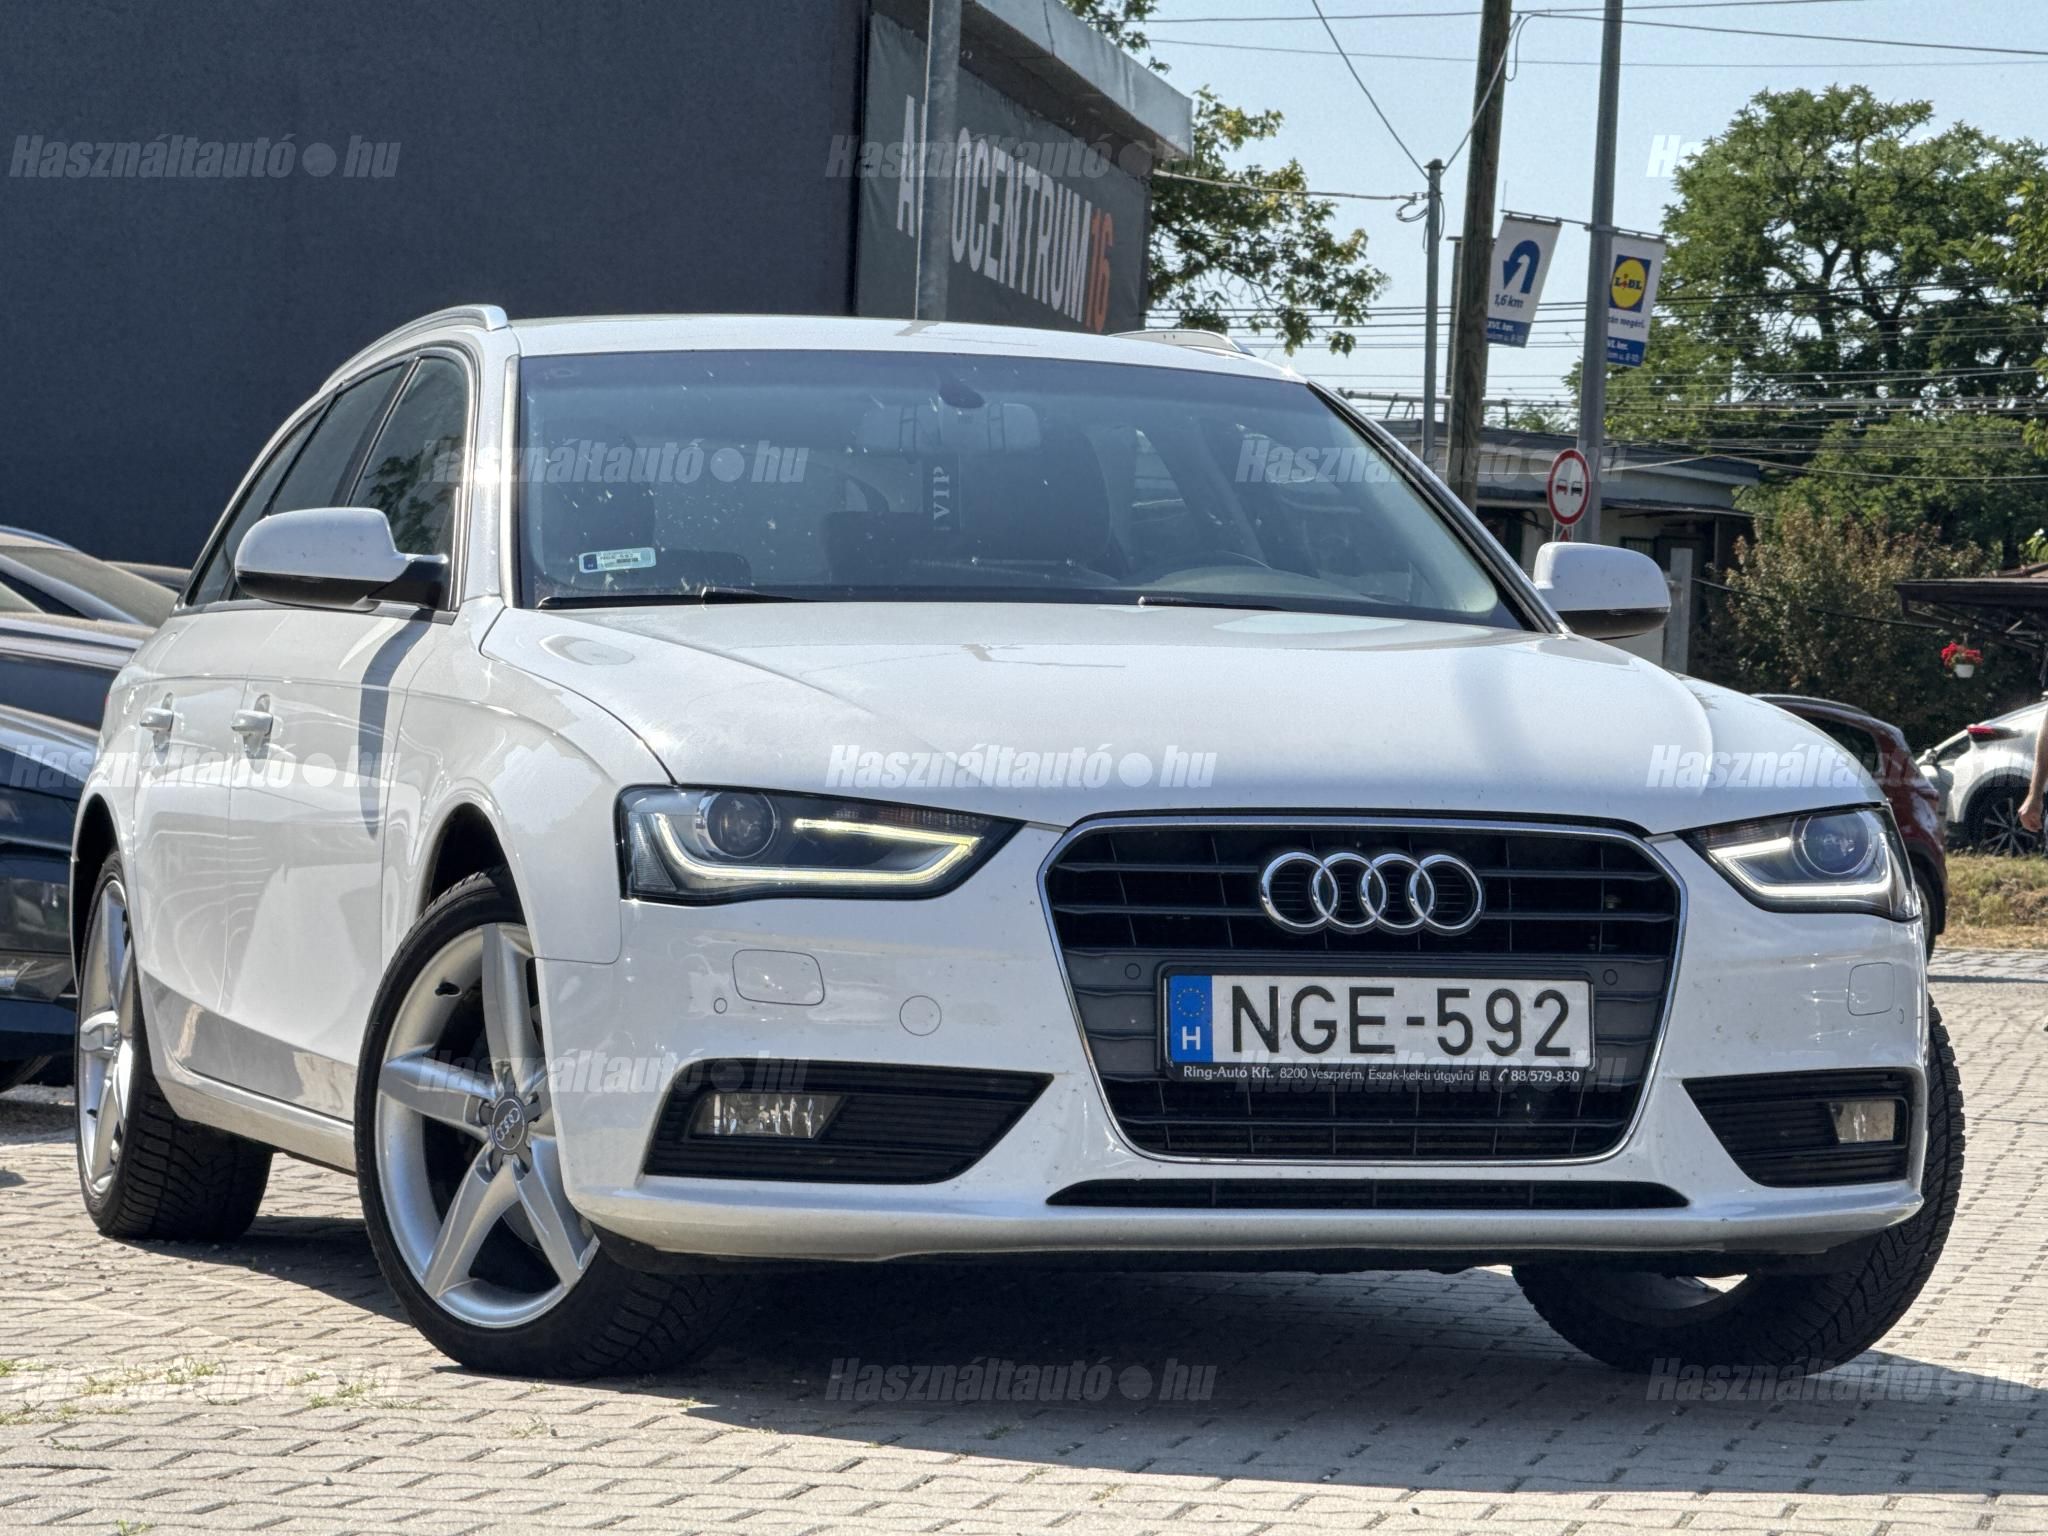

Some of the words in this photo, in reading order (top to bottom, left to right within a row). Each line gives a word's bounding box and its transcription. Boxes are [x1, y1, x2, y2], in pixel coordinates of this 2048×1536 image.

[897, 94, 1112, 332] AOCENTRUM16
[1508, 295, 1523, 309] km
[1181, 1026, 1201, 1050] H
[1232, 985, 1571, 1056] NGE-592
[1184, 1065, 1247, 1080] Ring-Autó
[1252, 1066, 1274, 1079] Kft.
[1279, 1068, 1308, 1079] 8200
[1311, 1067, 1365, 1081] Veszprém,
[1369, 1065, 1431, 1081] Észak-keleti
[1511, 1070, 1579, 1082] 88/579-830
